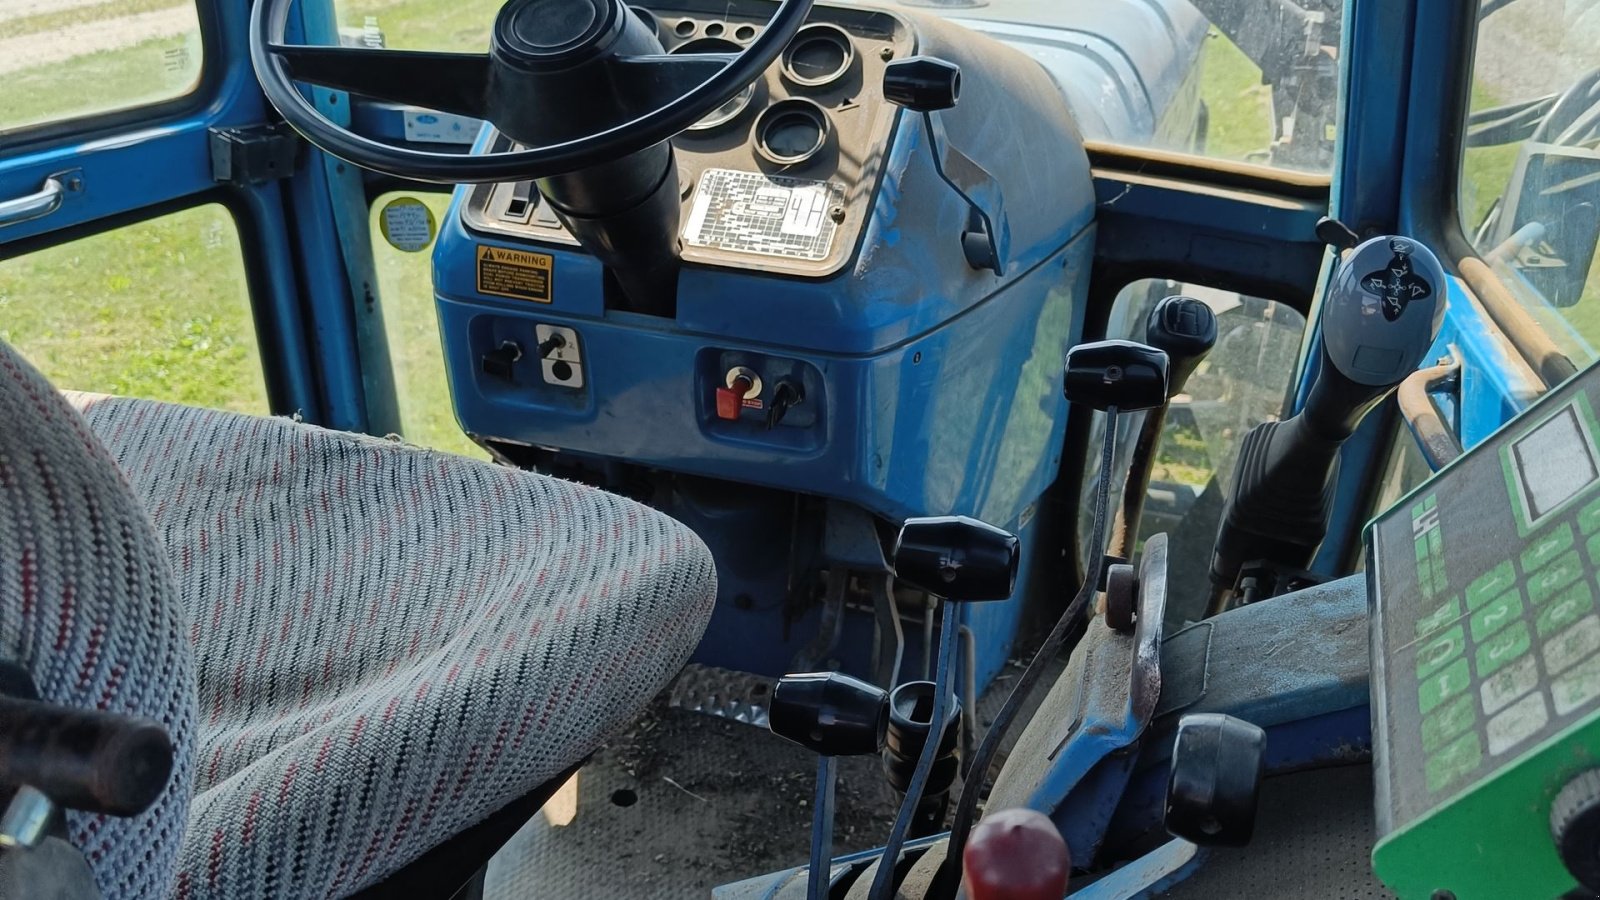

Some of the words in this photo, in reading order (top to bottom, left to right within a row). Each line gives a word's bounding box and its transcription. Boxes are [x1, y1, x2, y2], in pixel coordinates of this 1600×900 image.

[496, 250, 546, 266] WARNING
[1535, 540, 1558, 557] 4
[1479, 577, 1500, 592] 1
[1541, 567, 1567, 588] 5
[1484, 605, 1509, 627] 2
[1550, 599, 1577, 621] 6
[1489, 640, 1514, 660] 3
